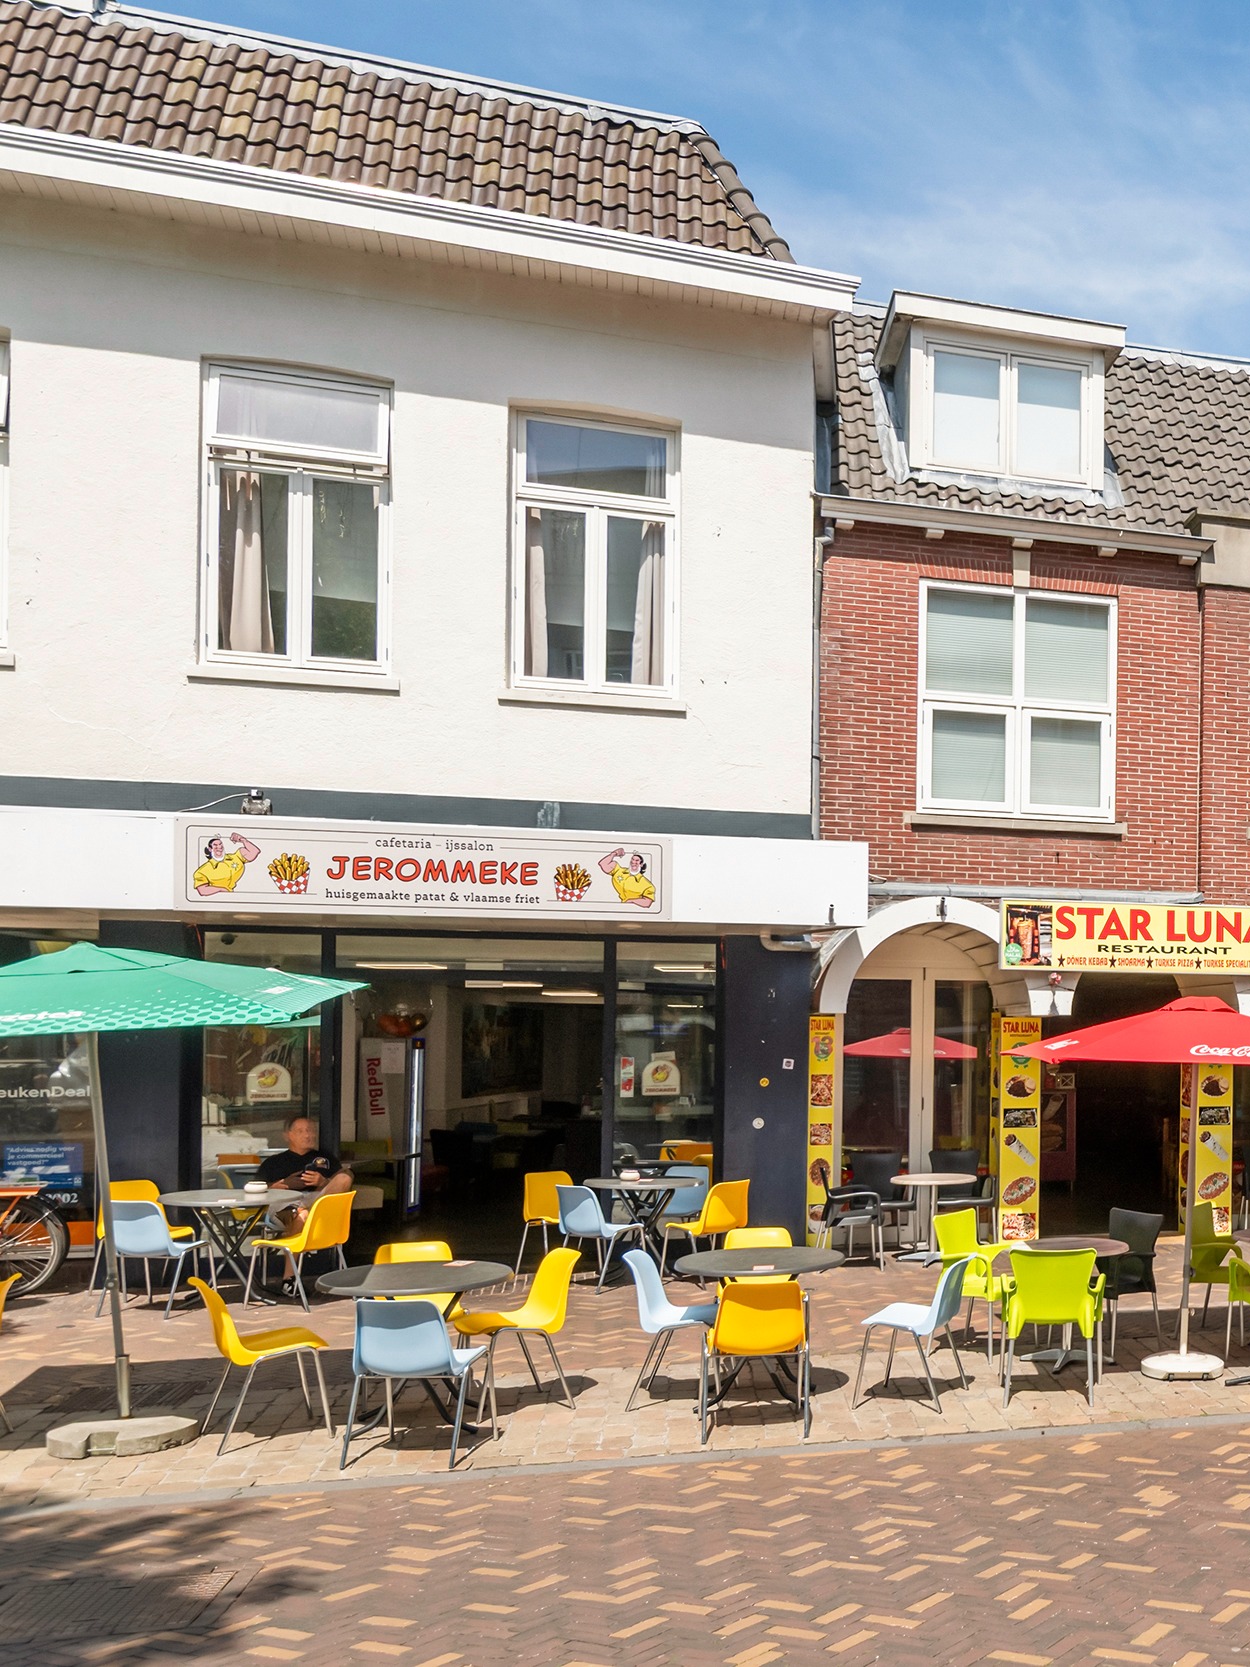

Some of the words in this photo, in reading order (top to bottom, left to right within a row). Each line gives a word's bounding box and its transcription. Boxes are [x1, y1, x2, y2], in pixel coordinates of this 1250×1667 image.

[375, 837, 432, 849] cafetaria
[445, 839, 494, 853] ijssalon
[326, 855, 540, 886] JEROMMEKE
[325, 888, 411, 902] huisgemaakte
[414, 891, 446, 904] patat
[449, 892, 459, 902] &
[463, 892, 511, 904] vlaamse
[515, 893, 540, 904] friet
[1055, 905, 1153, 942] STAR
[1097, 944, 1232, 955] RESTAURANT
[1088, 957, 1108, 966] KEBAB
[1118, 957, 1145, 967] SHOARMA
[1177, 959, 1194, 968] PIZZA
[1003, 1022, 1019, 1033] STAR
[1021, 1022, 1040, 1033] LUNA
[366, 1057, 384, 1087] Red
[368, 1088, 386, 1116] Bull
